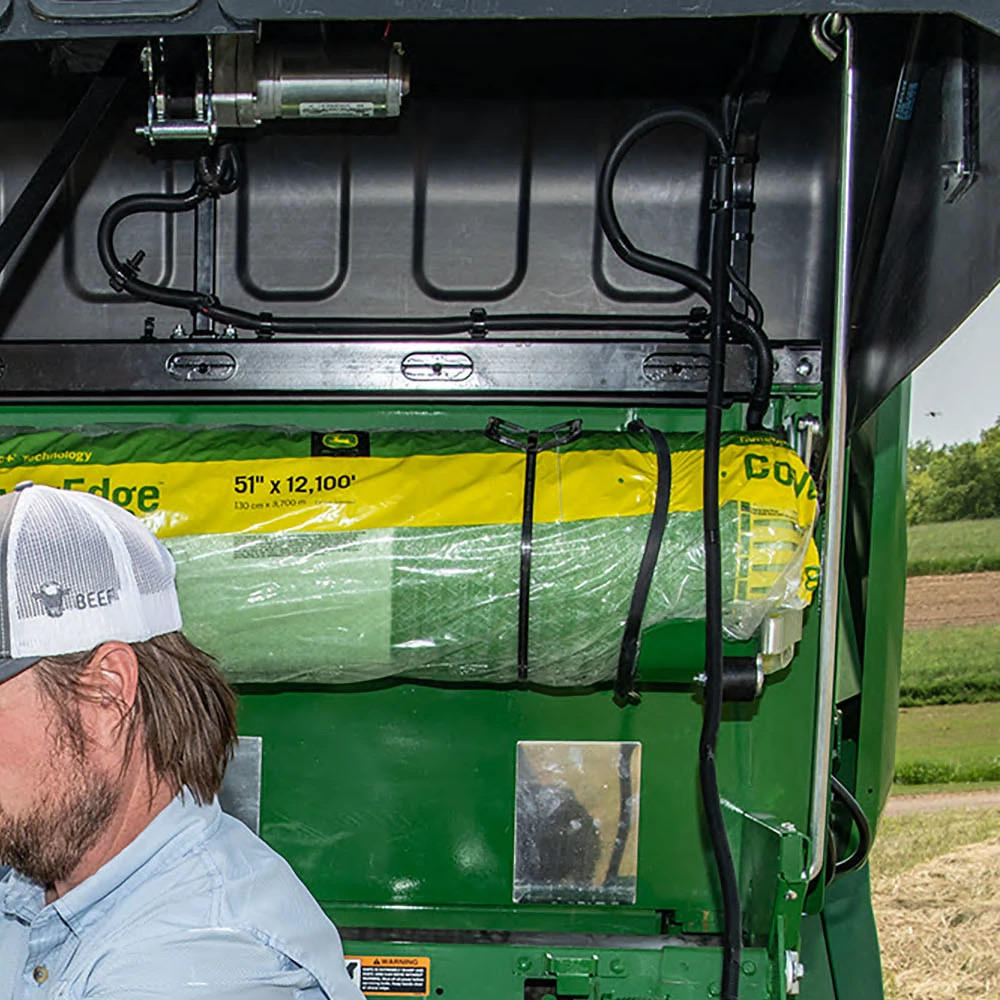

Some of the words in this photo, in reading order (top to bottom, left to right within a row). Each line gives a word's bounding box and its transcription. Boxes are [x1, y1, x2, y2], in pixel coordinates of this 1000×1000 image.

[234, 475, 264, 494] 51"
[270, 480, 281, 494] x
[286, 474, 356, 494] 12,100'
[77, 588, 119, 610] BEEF
